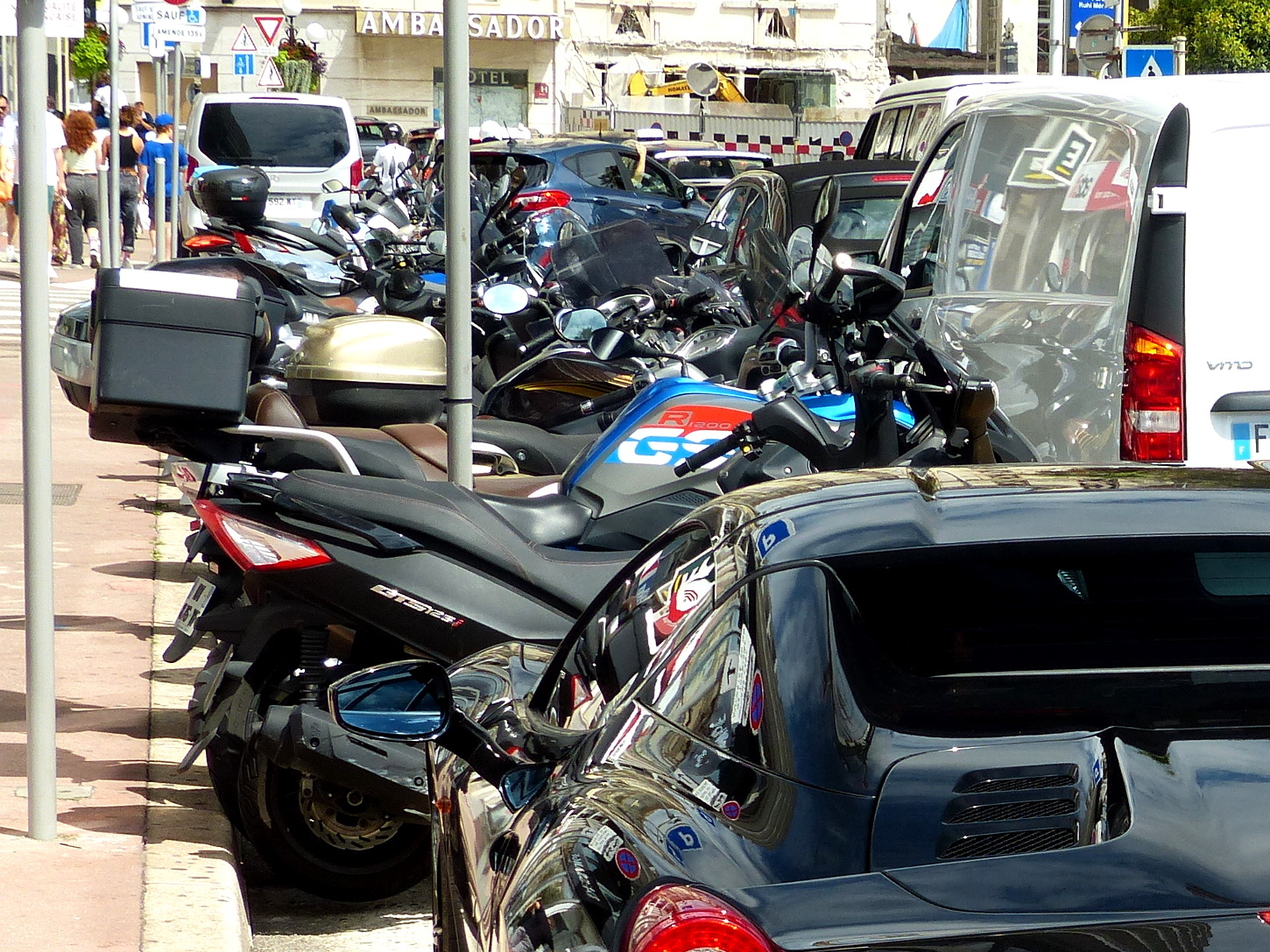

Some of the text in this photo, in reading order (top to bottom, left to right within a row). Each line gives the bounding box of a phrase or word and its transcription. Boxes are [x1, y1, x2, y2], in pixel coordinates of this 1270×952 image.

[156, 10, 185, 20] SAUF
[361, 11, 564, 40] AMBASADOR
[469, 70, 509, 85] OTEL
[369, 106, 426, 116] AMBASSADOR
